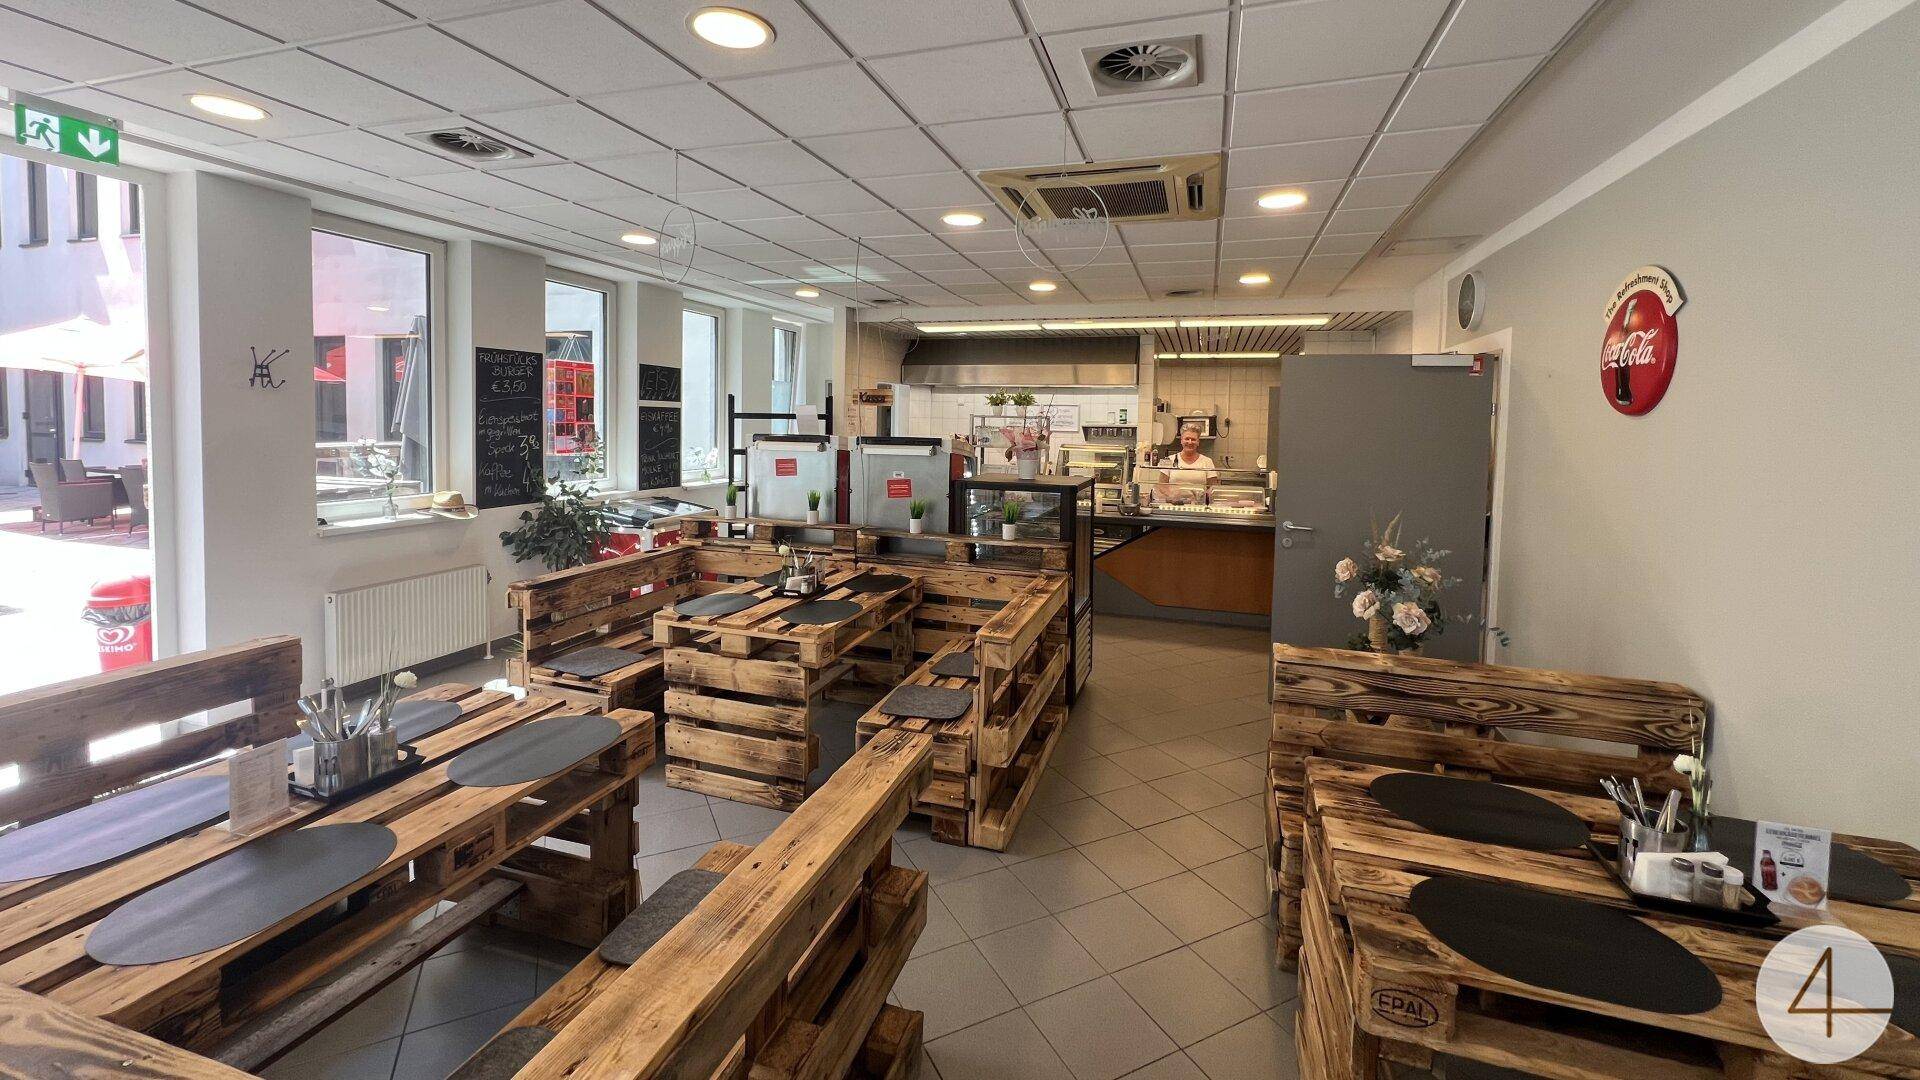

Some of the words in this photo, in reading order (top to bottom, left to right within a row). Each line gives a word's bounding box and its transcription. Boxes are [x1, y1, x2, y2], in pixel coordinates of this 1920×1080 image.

[1605, 301, 1617, 319] The
[1617, 273, 1660, 301] Refreshment
[1660, 279, 1673, 304] Shop
[491, 365, 534, 378] BURGER
[491, 380, 527, 395] €3,50
[99, 643, 134, 653] SKIMO
[1379, 993, 1428, 1023] EPAL
